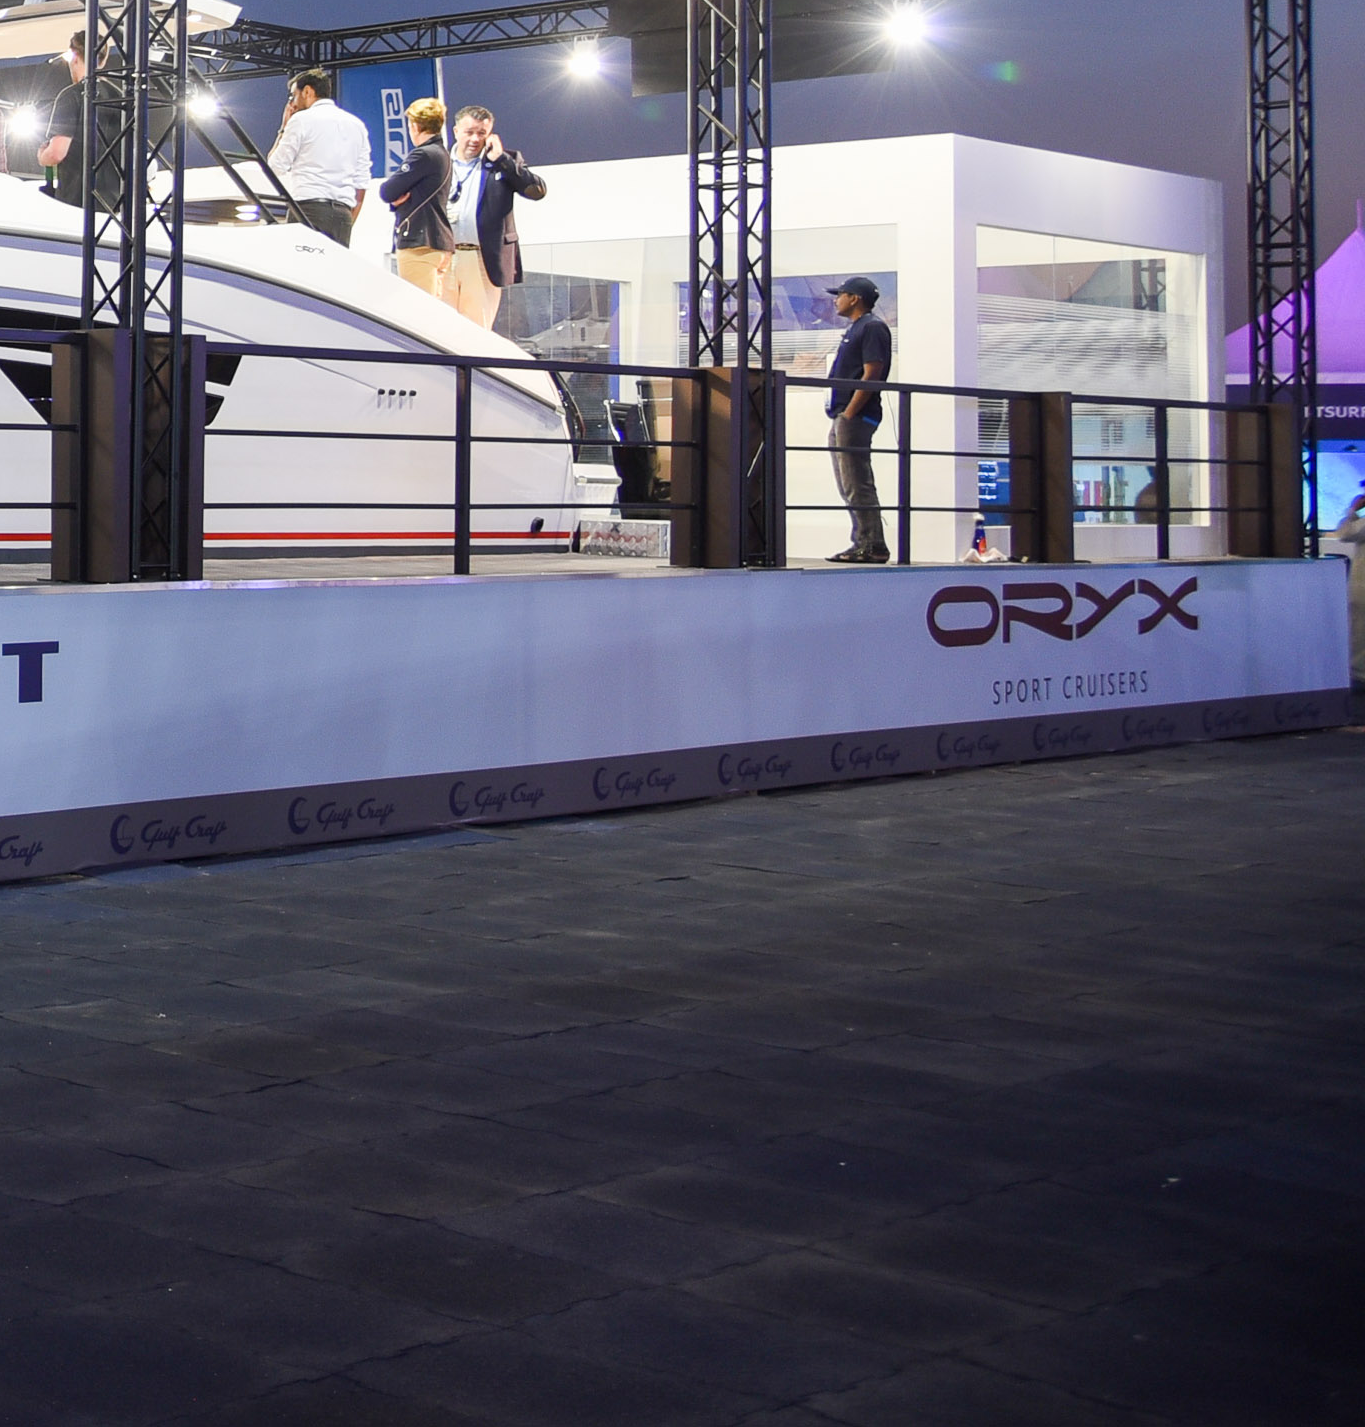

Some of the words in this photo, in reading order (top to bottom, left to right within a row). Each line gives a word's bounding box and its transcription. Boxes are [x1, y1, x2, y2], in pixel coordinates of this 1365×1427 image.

[926, 576, 1198, 647] ORYX
[992, 677, 1052, 705] SPORT
[1062, 671, 1149, 699] CRUISERS
